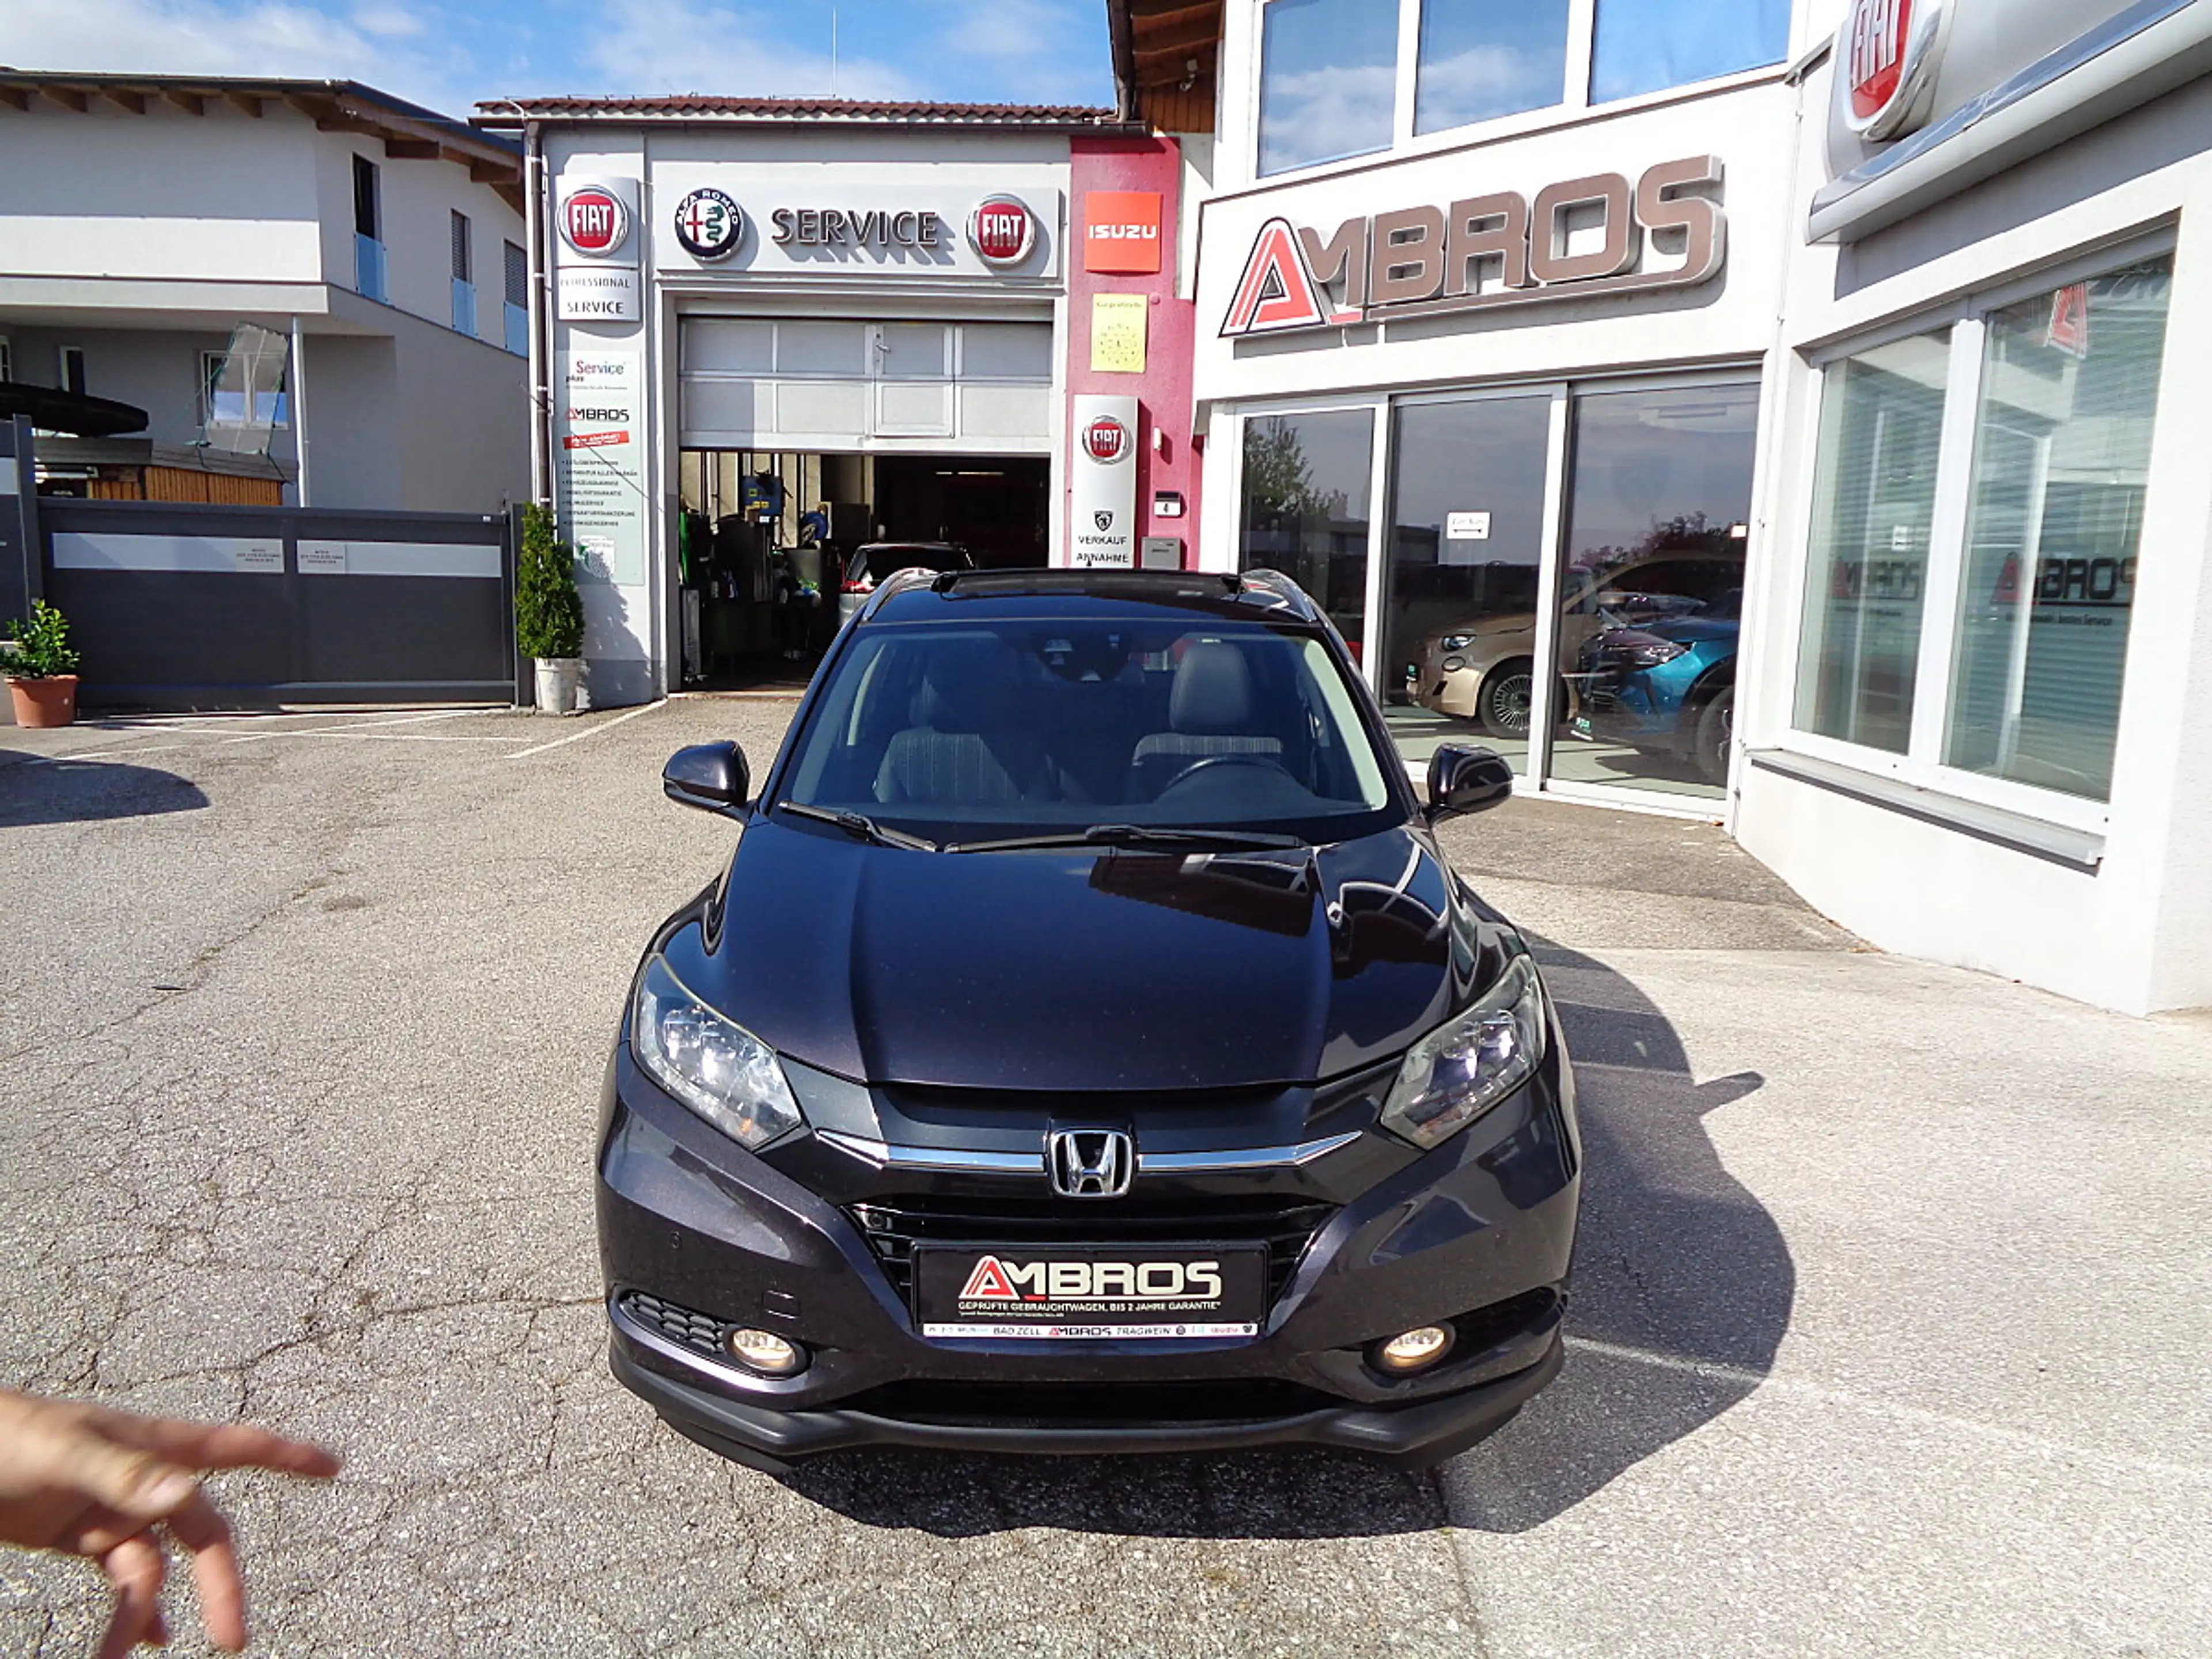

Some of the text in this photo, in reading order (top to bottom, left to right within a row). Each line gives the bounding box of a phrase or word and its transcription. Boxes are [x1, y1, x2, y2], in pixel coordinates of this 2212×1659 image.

[573, 204, 611, 234] FIAT
[770, 208, 937, 246] SERVICE
[982, 214, 1022, 243] FIAT
[1089, 224, 1157, 239] ISUZU
[1218, 154, 1727, 338] AMBROS
[567, 300, 624, 314] SERVICE
[576, 359, 624, 374] Service
[566, 407, 630, 423] AMBROS
[1093, 429, 1119, 448] FIAT
[1163, 503, 1169, 513] 4
[1078, 535, 1127, 545] VERKAUF
[1076, 552, 1129, 563] ANNAHME
[958, 1255, 1222, 1300] AMBROS
[1109, 1302, 1126, 1312] BIS
[1127, 1303, 1134, 1312] 2
[1135, 1302, 1166, 1312] JAHRE
[1048, 1327, 1111, 1336] AMBROS
